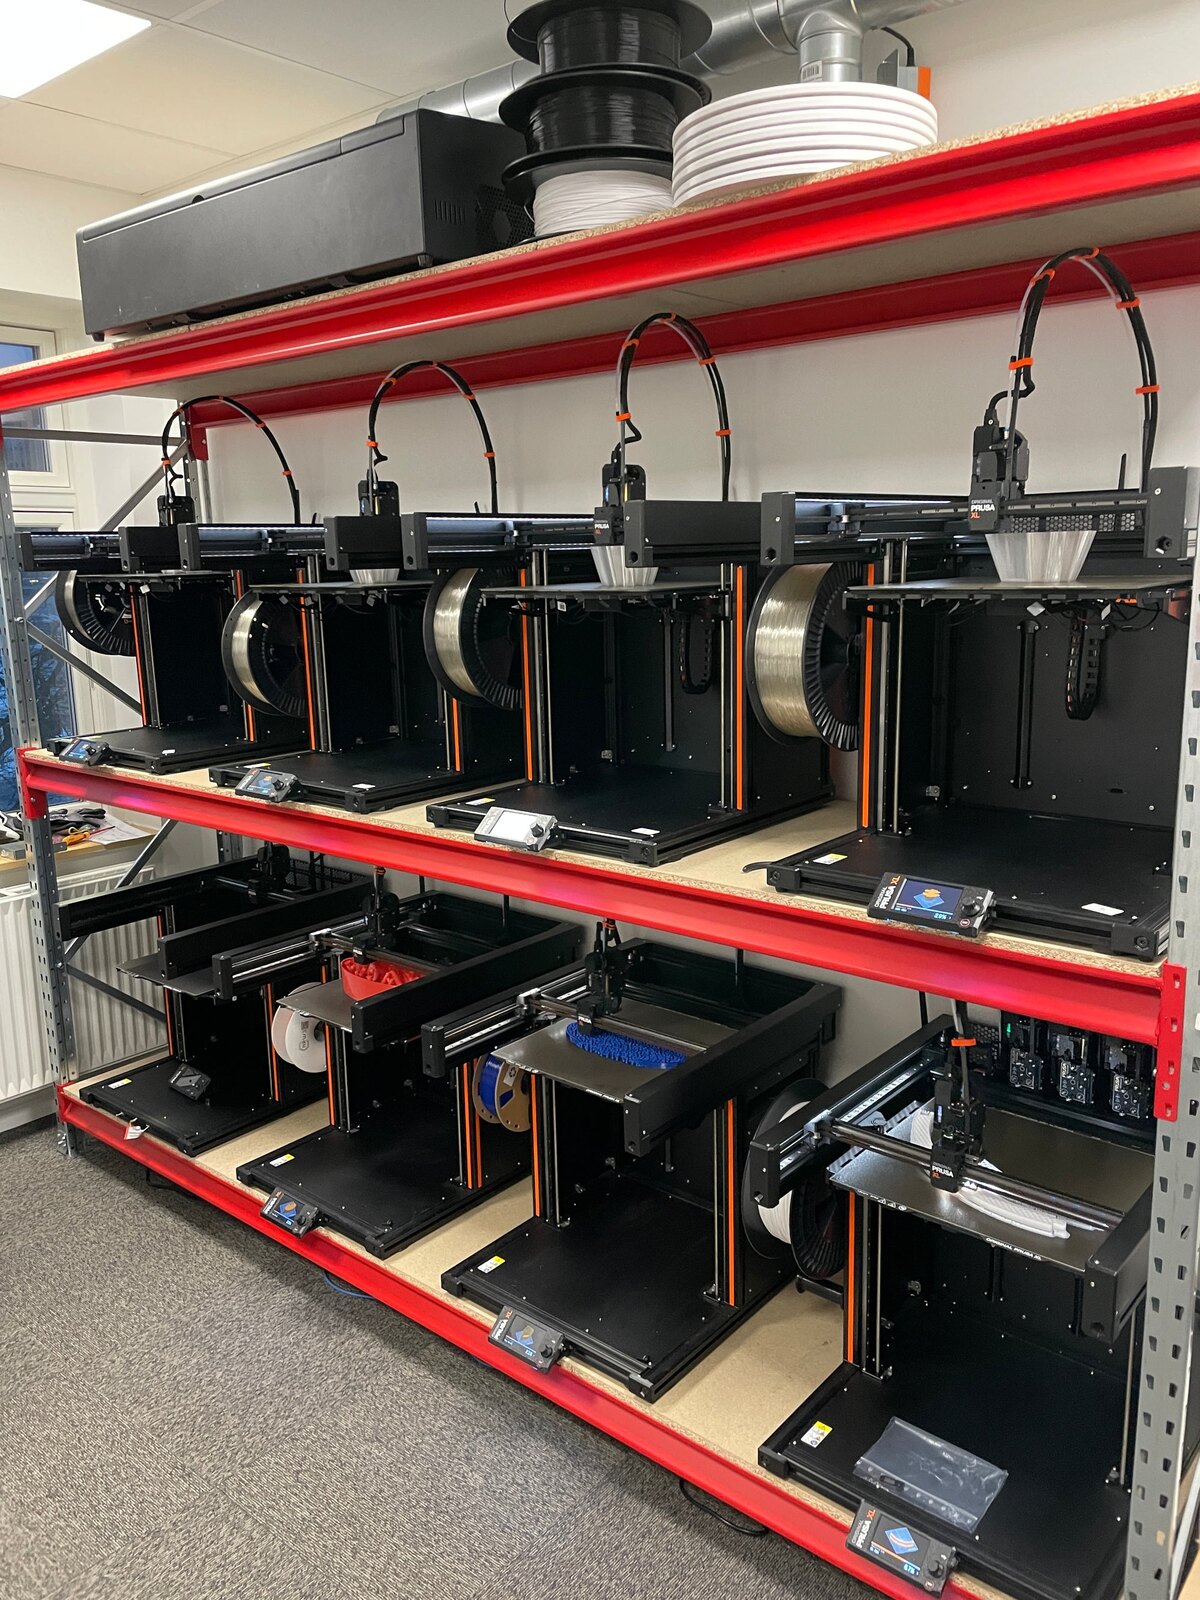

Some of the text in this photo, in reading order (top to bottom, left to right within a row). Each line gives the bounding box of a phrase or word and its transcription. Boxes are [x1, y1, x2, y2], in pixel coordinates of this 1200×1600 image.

[970, 504, 995, 512] PRUSA
[970, 511, 981, 519] XL
[879, 875, 901, 909] PRUSA XL
[931, 1165, 954, 1178] PRUSA
[985, 1237, 1013, 1250] ORIGINAL
[1013, 1247, 1034, 1258] PRUSA
[494, 1318, 509, 1340] PRUSA
[856, 1509, 876, 1549] PRUSA XL
